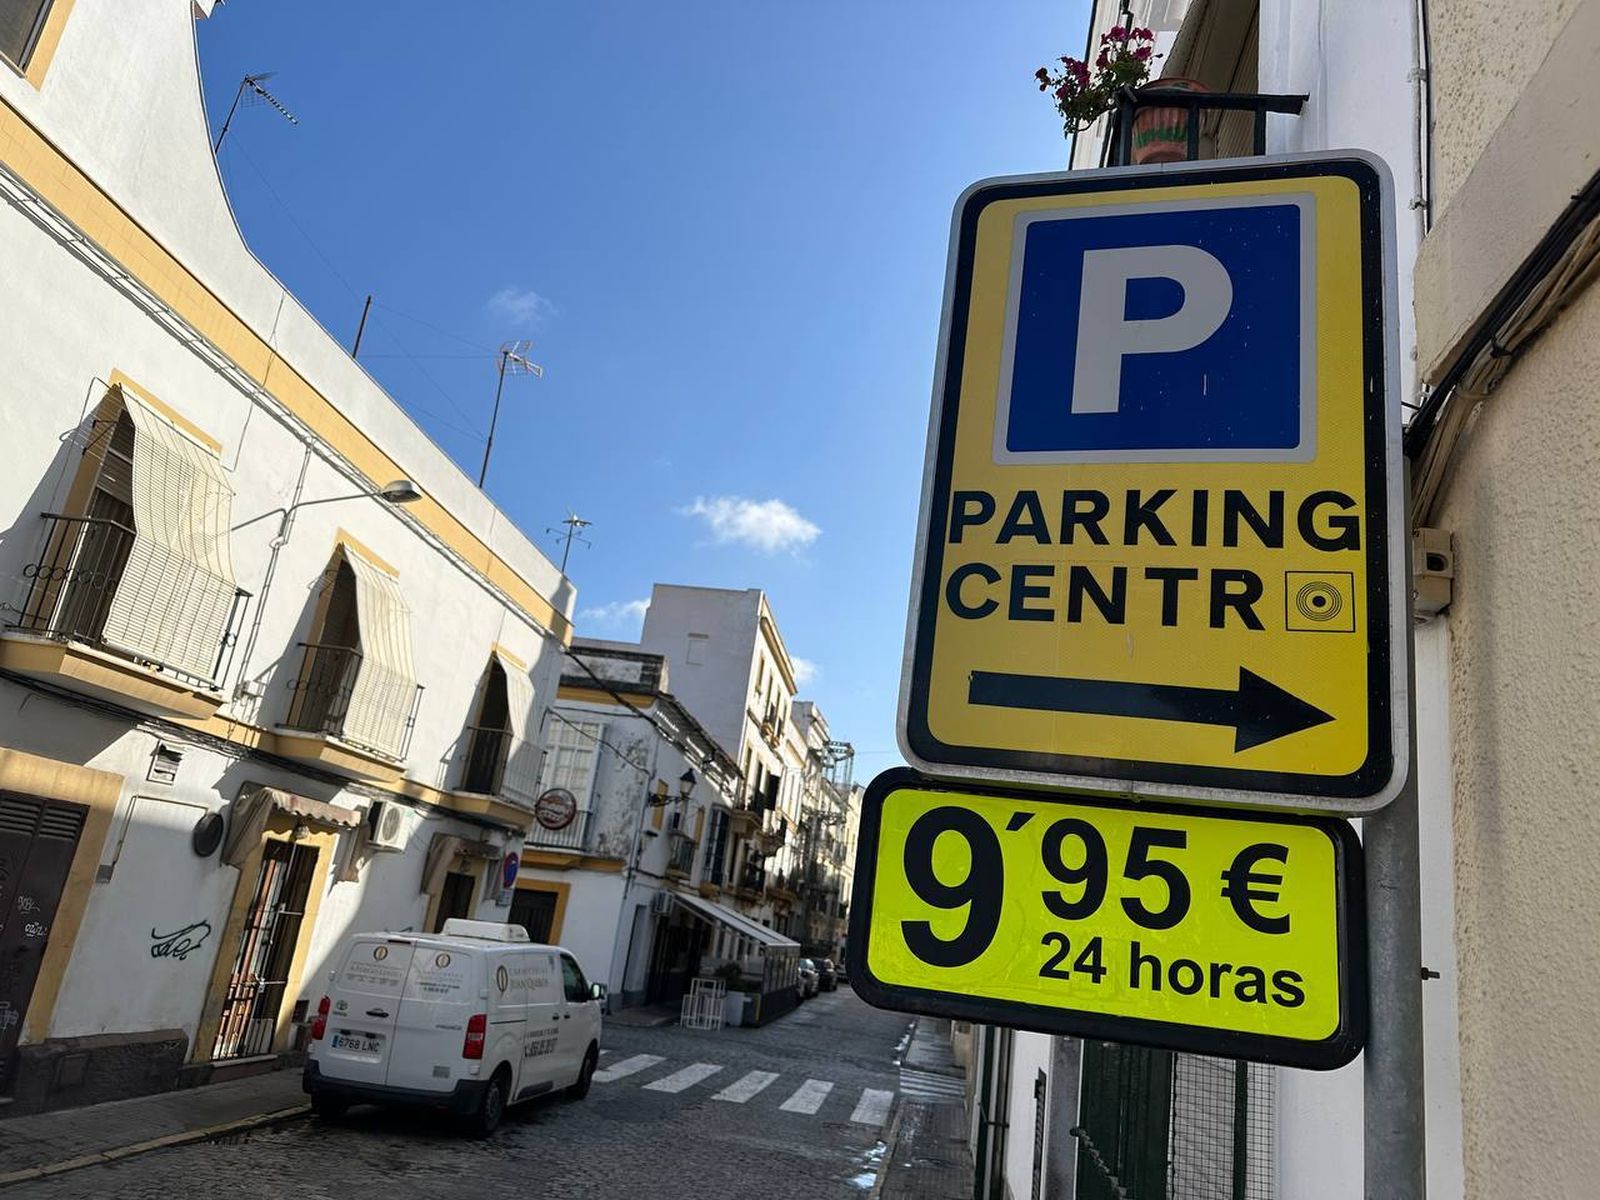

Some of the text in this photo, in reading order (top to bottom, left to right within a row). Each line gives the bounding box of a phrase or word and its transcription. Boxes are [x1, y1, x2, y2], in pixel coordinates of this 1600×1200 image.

[1071, 245, 1233, 413] P
[948, 489, 1361, 553] PARKING
[1220, 842, 1290, 935] €
[1039, 931, 1305, 1008] 24 horas
